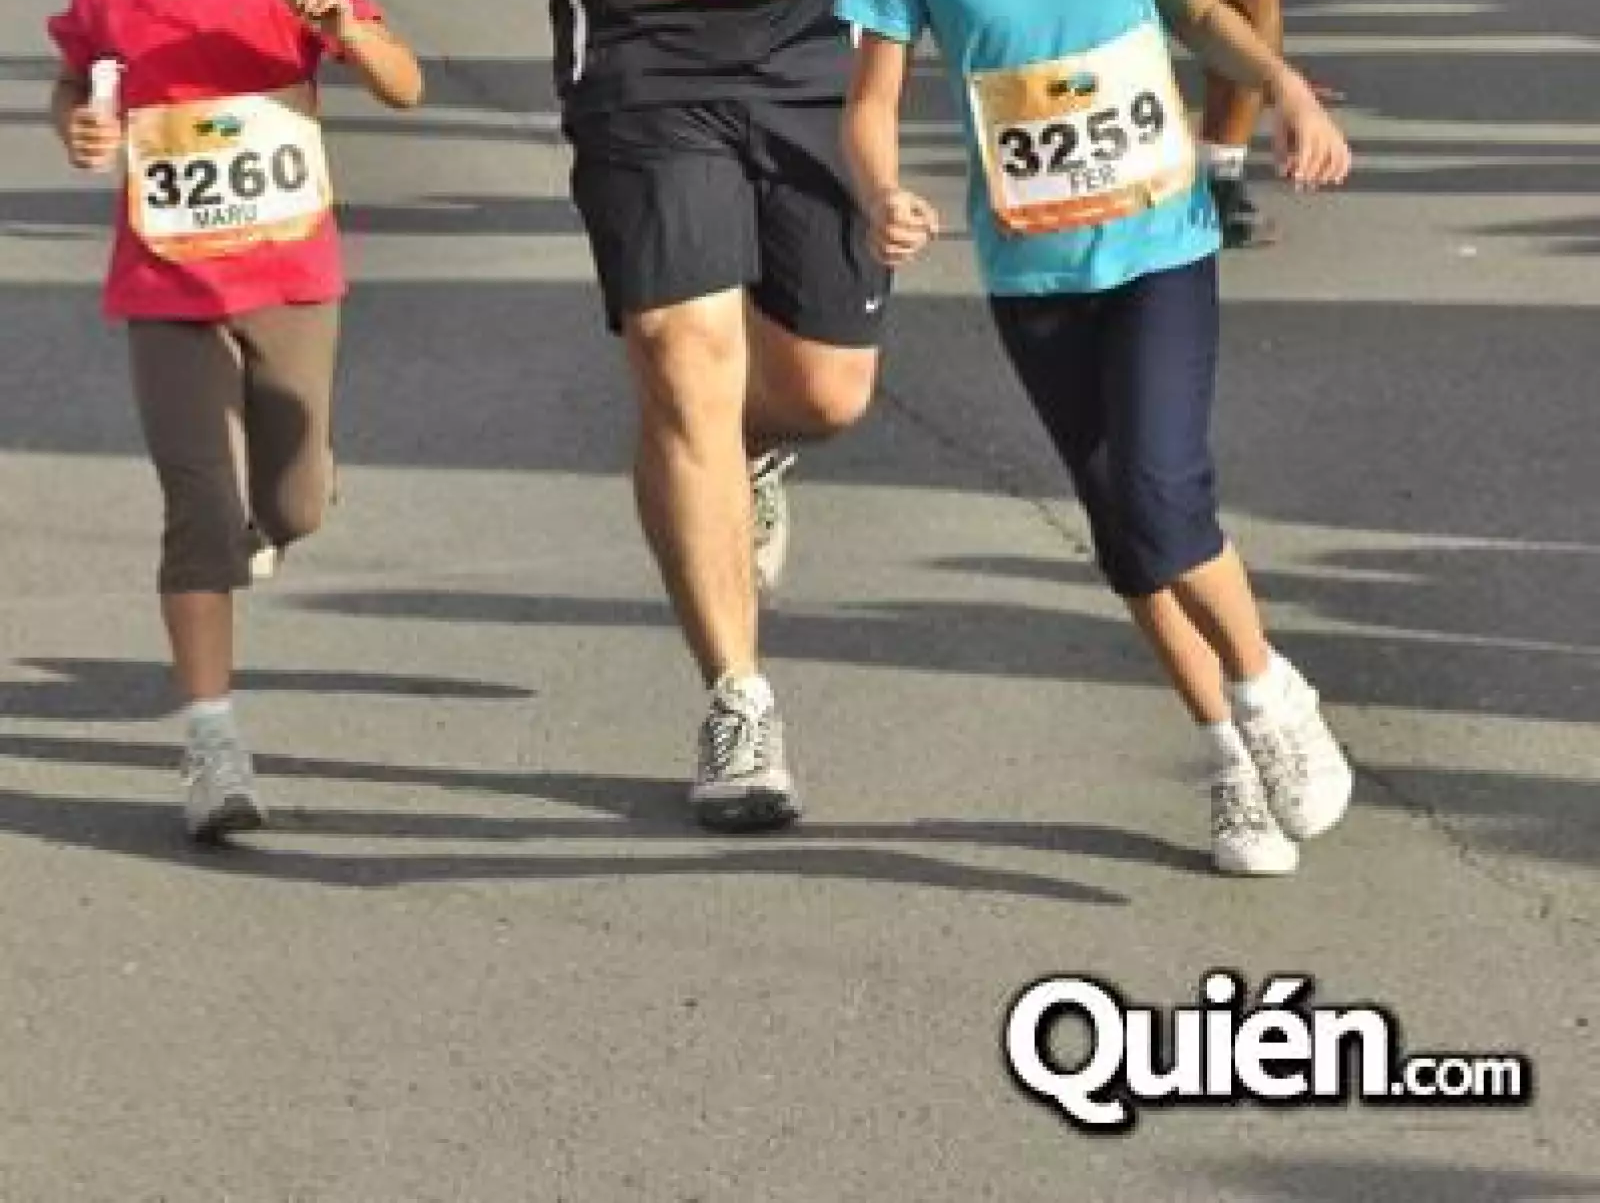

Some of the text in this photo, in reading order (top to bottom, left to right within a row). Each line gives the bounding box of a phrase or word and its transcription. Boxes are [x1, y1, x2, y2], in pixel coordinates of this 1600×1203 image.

[998, 90, 1165, 180] 3259
[145, 143, 309, 209] 3260
[1068, 163, 1116, 193] FER
